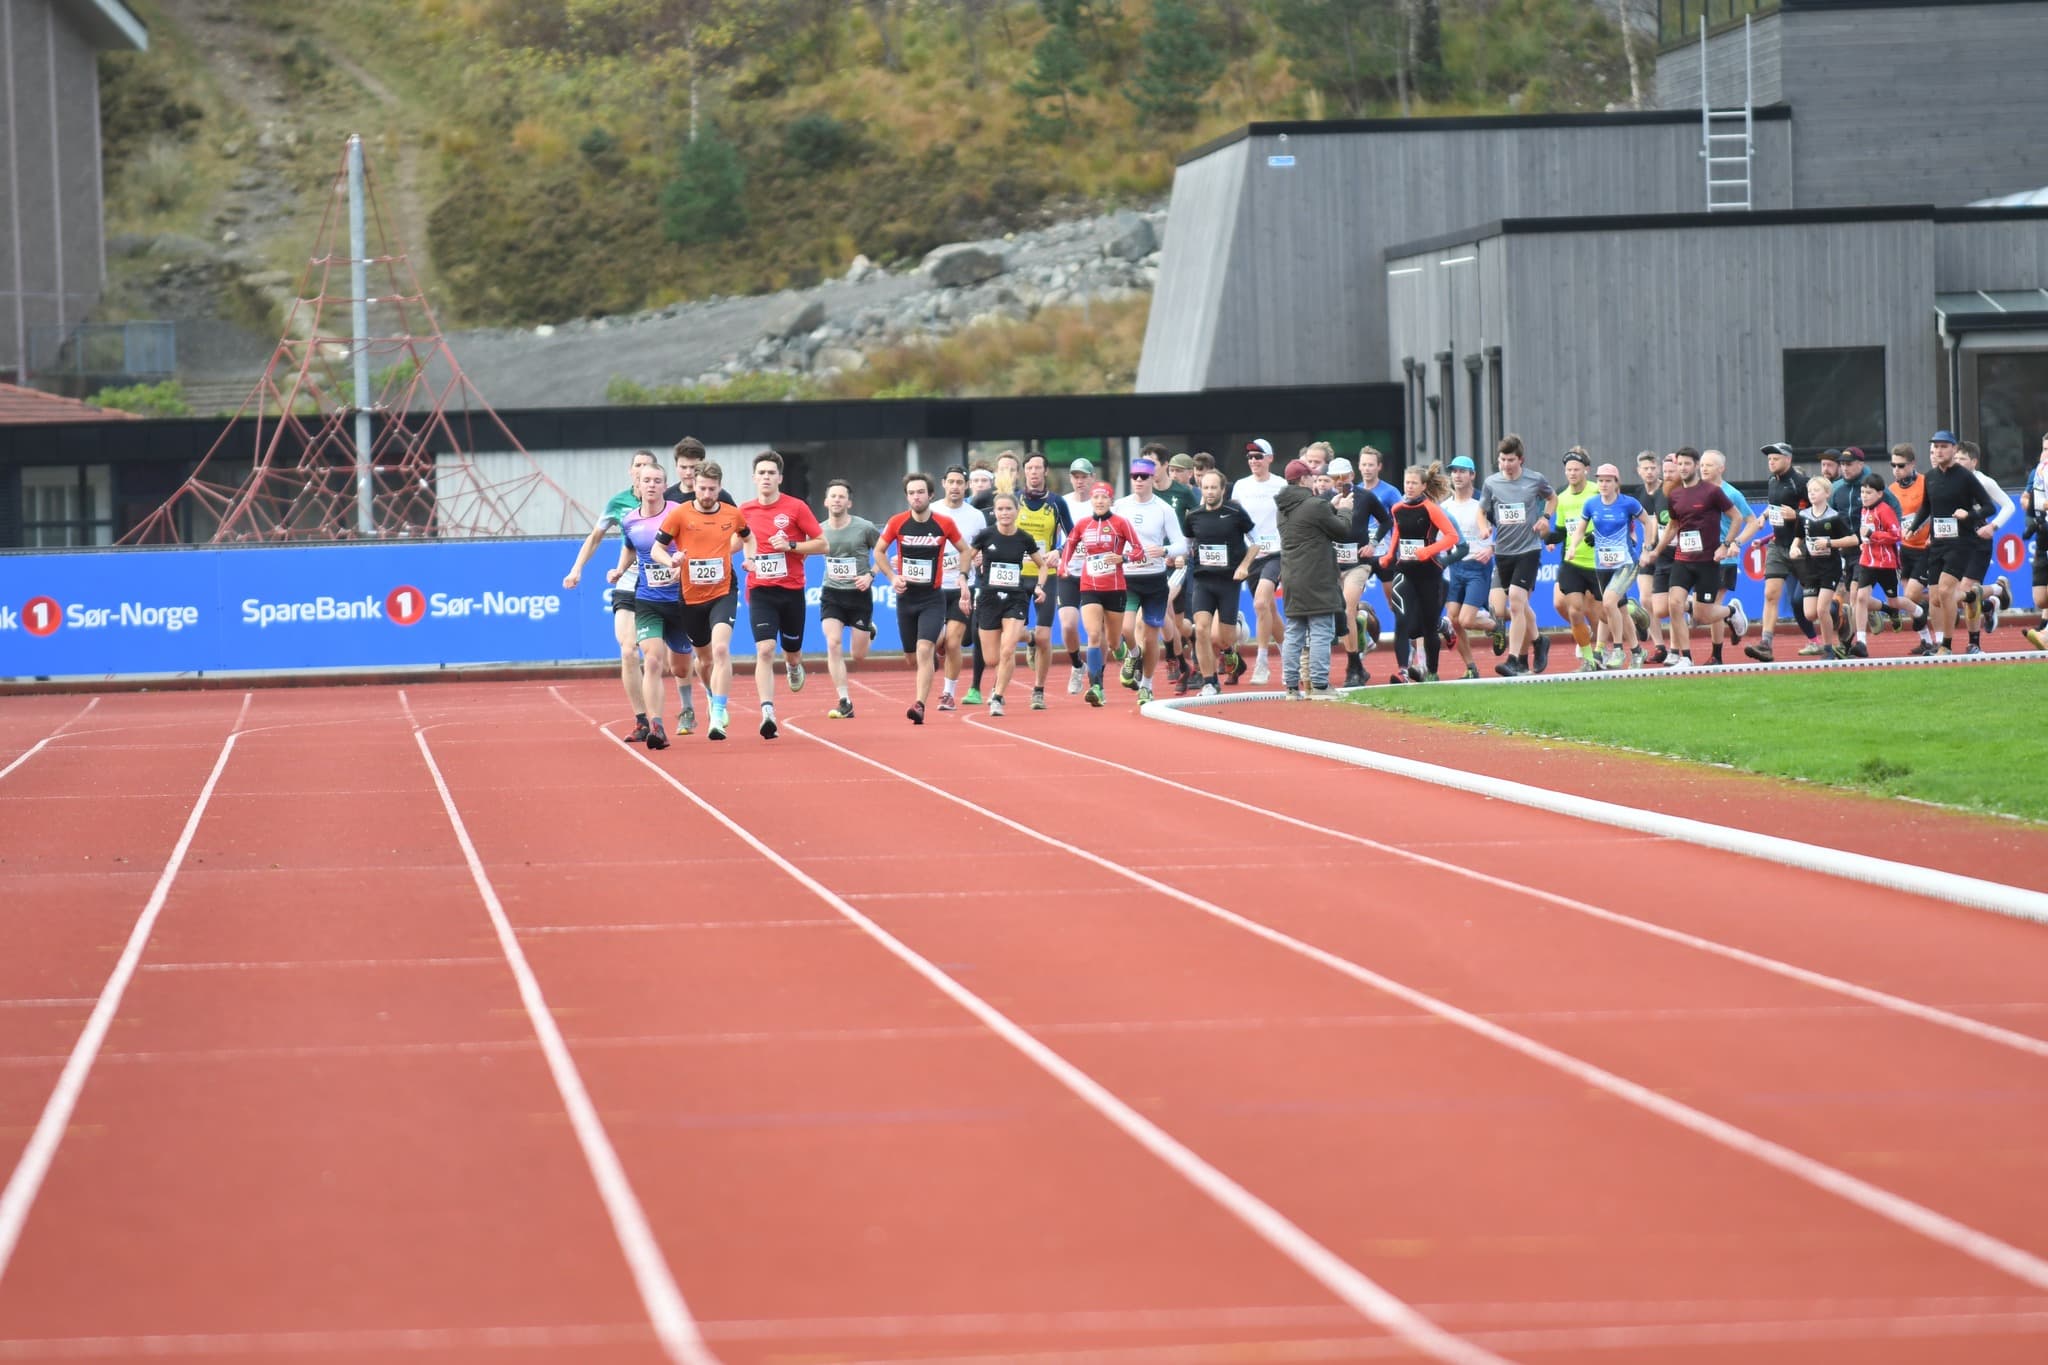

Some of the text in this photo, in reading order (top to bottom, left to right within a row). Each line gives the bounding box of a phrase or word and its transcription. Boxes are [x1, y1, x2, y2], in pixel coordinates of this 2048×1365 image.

[2004, 539, 2016, 564] 1
[760, 561, 778, 573] 827
[1751, 549, 1762, 574] 1
[653, 570, 672, 581] 824
[697, 567, 716, 579] 226
[833, 565, 849, 575] 863
[907, 566, 924, 577] 894
[997, 570, 1013, 581] 833
[33, 602, 48, 628] 1
[67, 602, 199, 631] Sør-Norge
[242, 592, 561, 629] SpareBank 1 Sør-Norge
